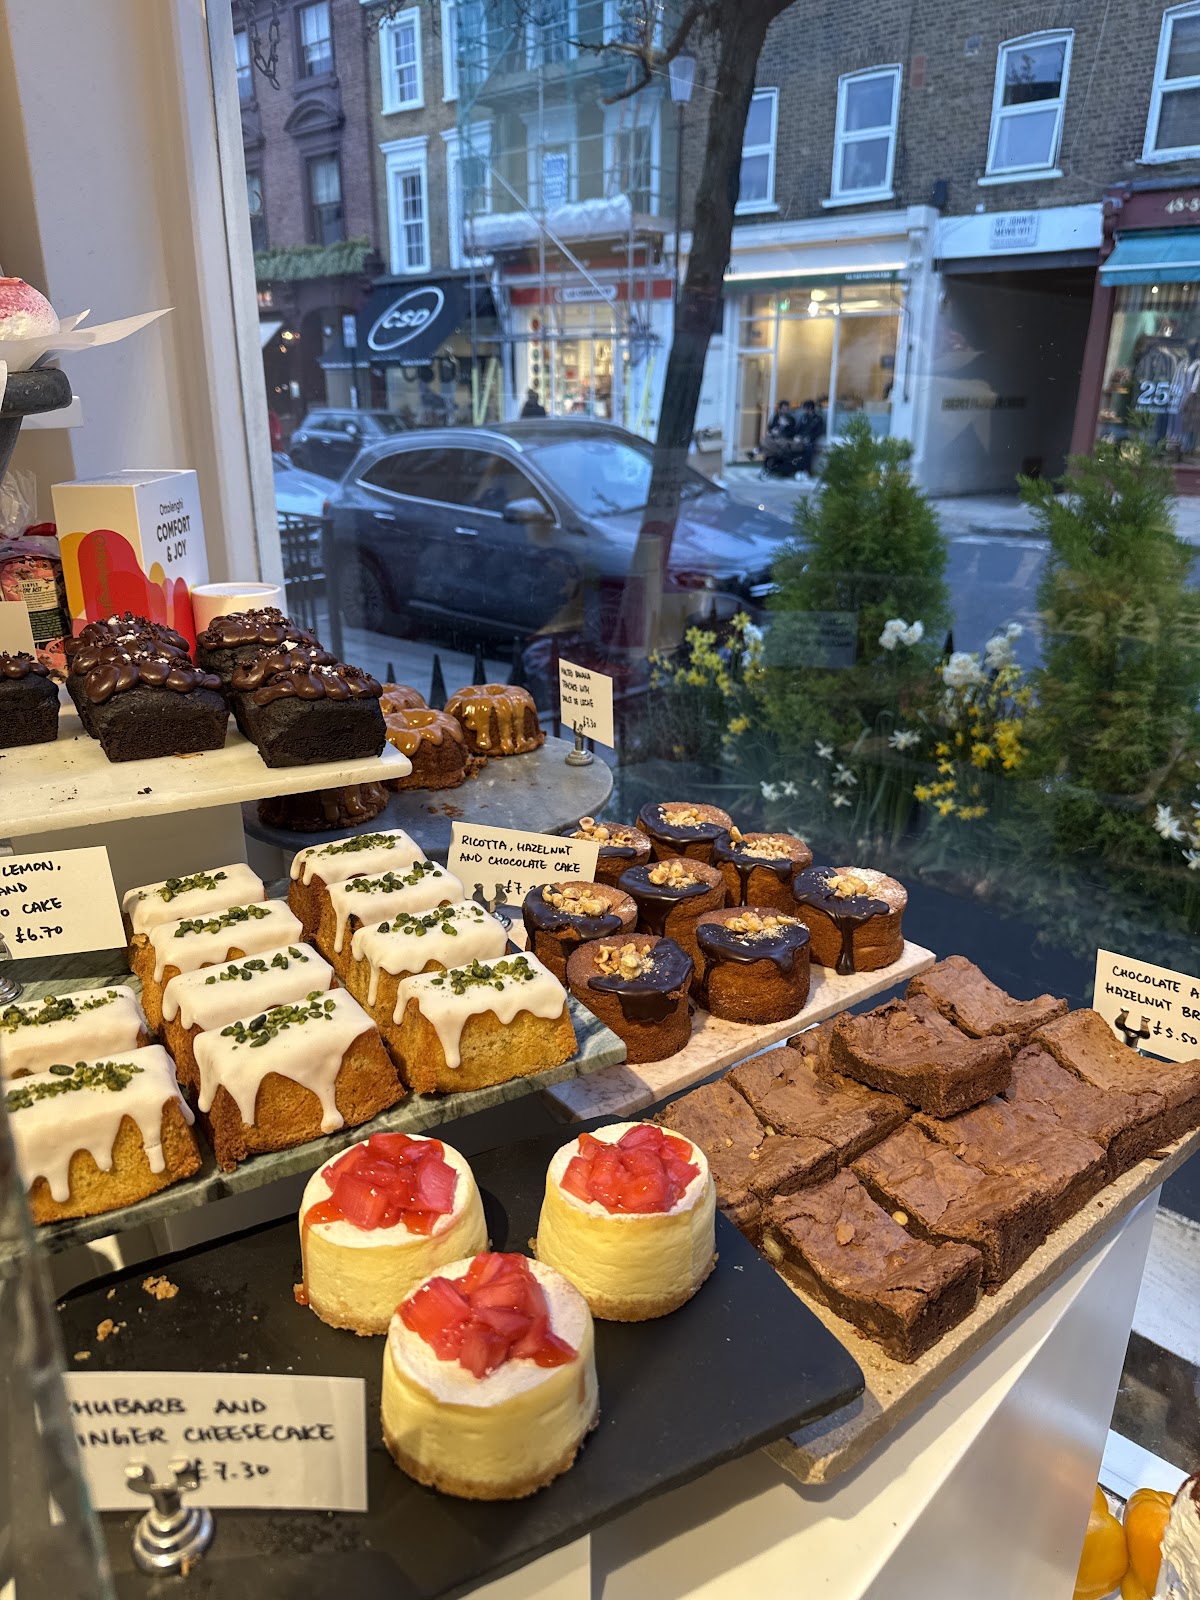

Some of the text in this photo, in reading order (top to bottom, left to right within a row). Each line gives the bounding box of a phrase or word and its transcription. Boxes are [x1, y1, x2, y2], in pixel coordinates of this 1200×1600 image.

[382, 308, 430, 329] CSD
[160, 497, 184, 516] Ottolenghi
[156, 514, 191, 543] COMFORT
[167, 539, 187, 563] & JOY
[93, 533, 115, 620] Ottolengh
[461, 835, 573, 856] RICOTTA, HAZELNUT
[459, 853, 581, 873] AND CHOCOLATE CAKE
[22, 897, 63, 914] CAKE
[16, 926, 63, 944] £6.70
[1112, 965, 1182, 993] CHOCOLATE
[1105, 982, 1173, 1011] HAZELNUT
[1153, 1020, 1198, 1045] £5.50
[72, 1398, 269, 1416] HUBARB AND
[77, 1422, 336, 1447] INGER CHEESECAKE
[194, 1457, 271, 1482] £7.30
